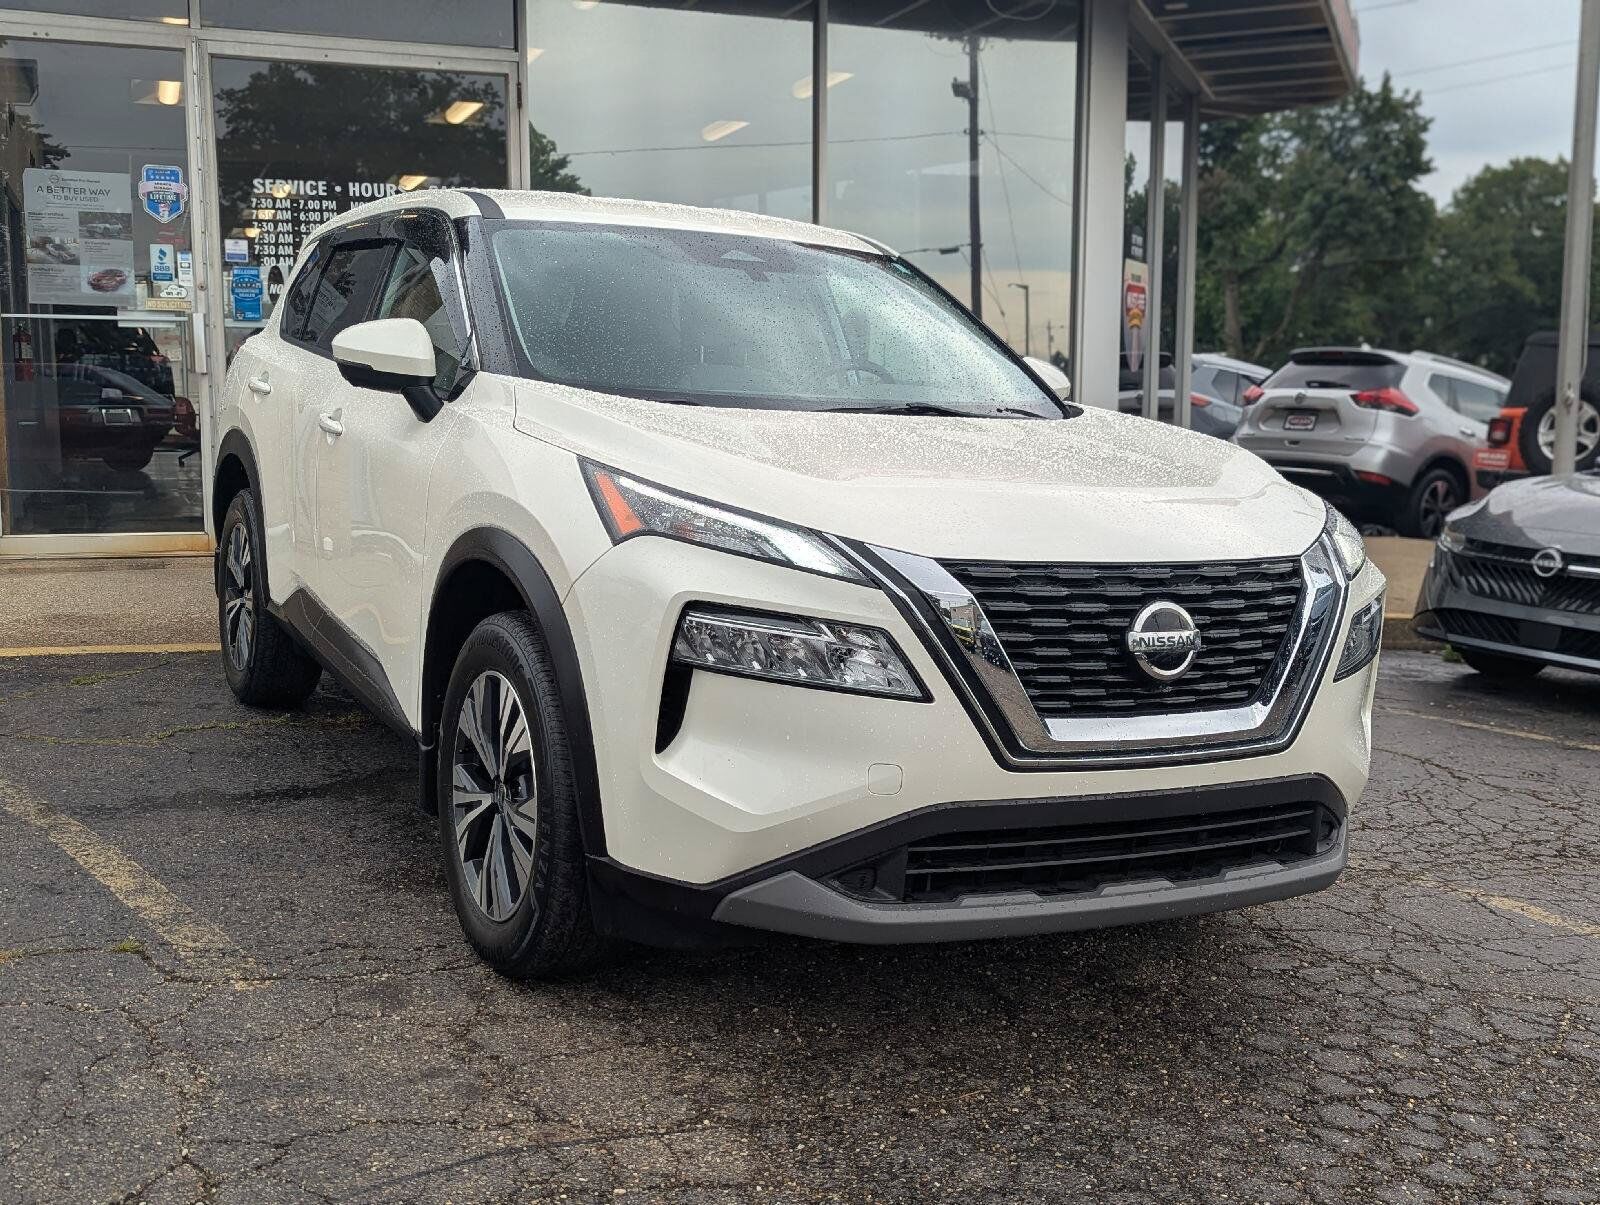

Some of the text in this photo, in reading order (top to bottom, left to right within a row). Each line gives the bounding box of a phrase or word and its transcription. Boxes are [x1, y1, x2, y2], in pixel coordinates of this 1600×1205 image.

[36, 185, 111, 197] A BETTER WAY
[252, 178, 328, 196] SERVICE
[251, 198, 273, 208] 7:30
[275, 199, 291, 209] AM
[322, 201, 337, 211] PM
[277, 210, 292, 220] AM
[300, 211, 321, 221] 6:00
[252, 222, 275, 232] 7:30
[277, 222, 293, 232] AM
[254, 233, 276, 243] 7:30
[278, 234, 294, 244] AM
[254, 245, 294, 255] 7:30 AM
[278, 256, 294, 267] AM
[147, 300, 191, 309] NO SOLICITING
[1138, 635, 1194, 649] NISSAN
